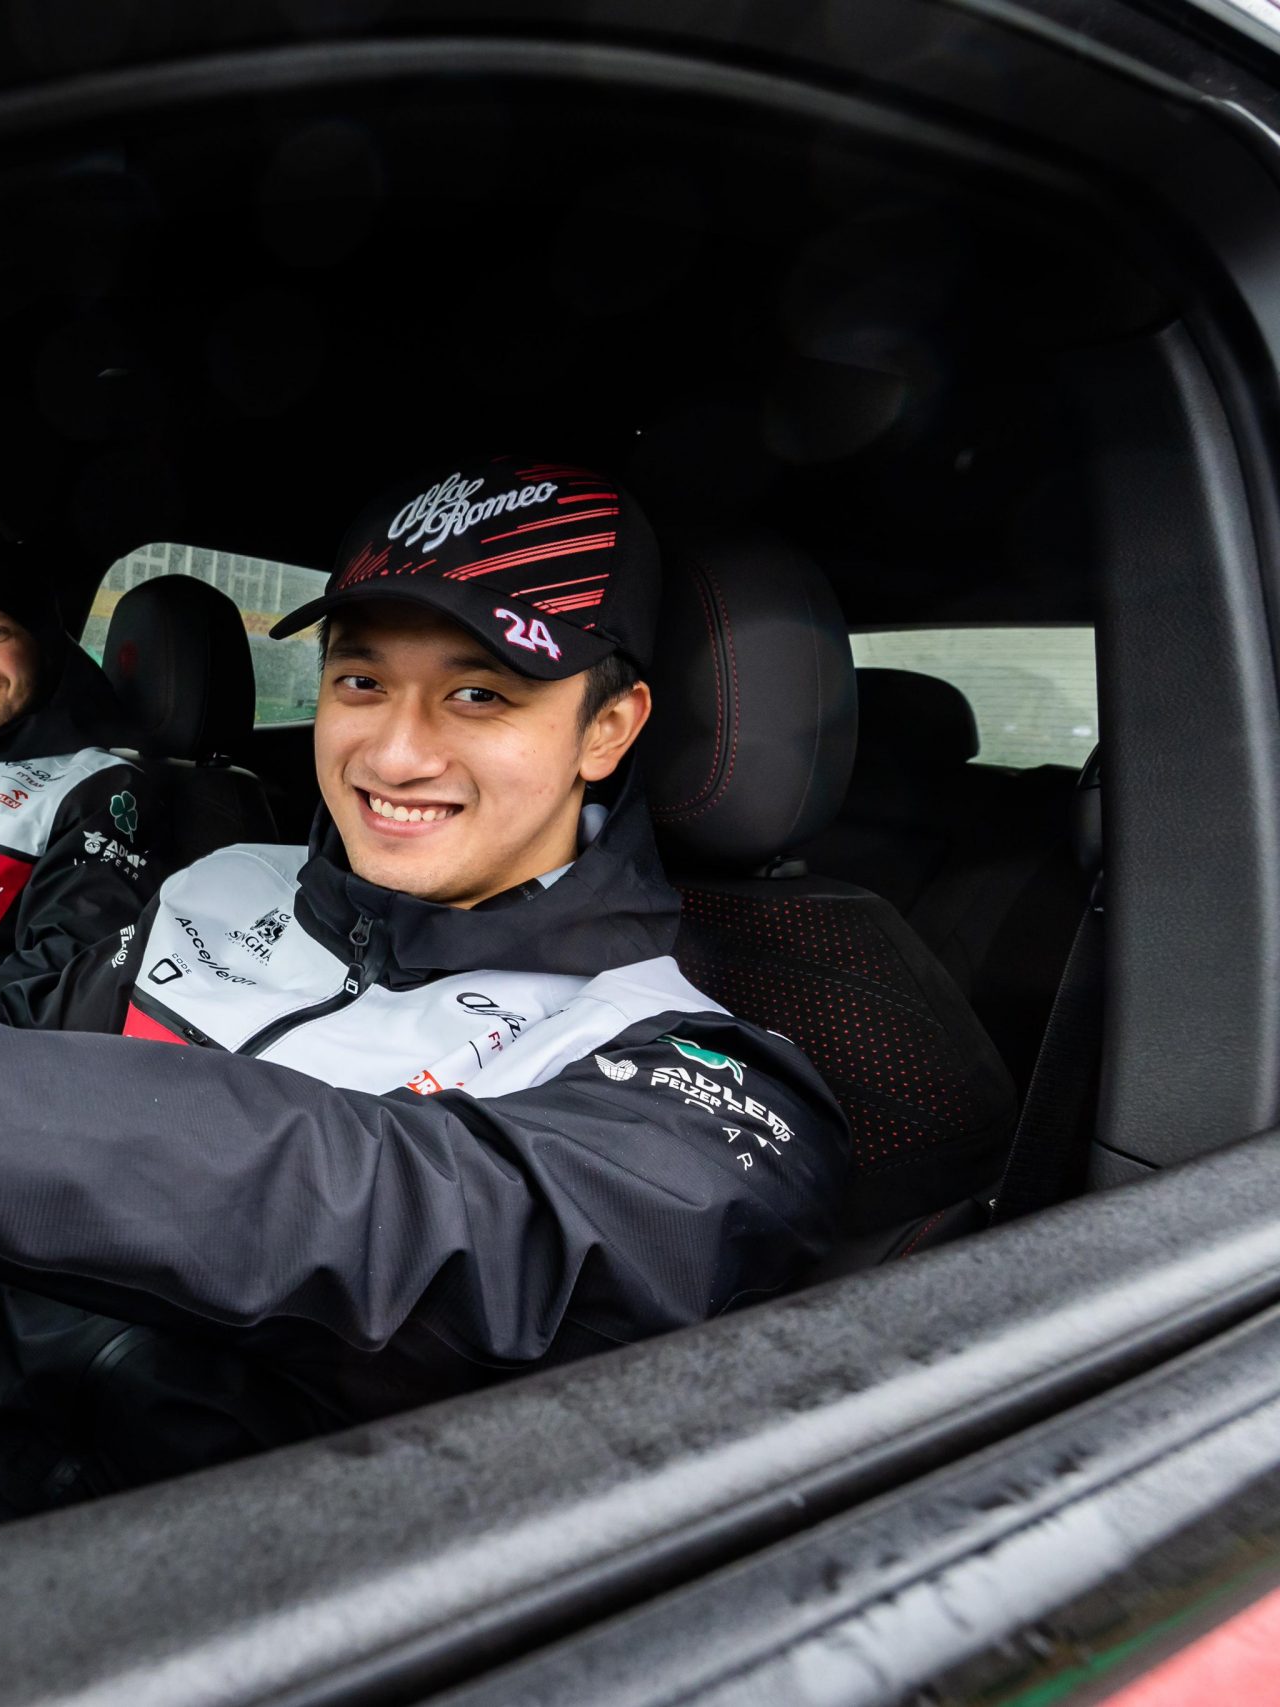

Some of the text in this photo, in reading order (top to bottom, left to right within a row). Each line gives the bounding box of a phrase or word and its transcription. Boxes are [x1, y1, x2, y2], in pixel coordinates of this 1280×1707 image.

[387, 472, 485, 547] Alfa
[422, 482, 559, 553] Romeo
[493, 607, 562, 661] 24
[171, 952, 193, 976] CODE
[174, 916, 258, 986] Accelleron
[650, 1072, 722, 1108] PELZER
[651, 1067, 795, 1136] ADLER
